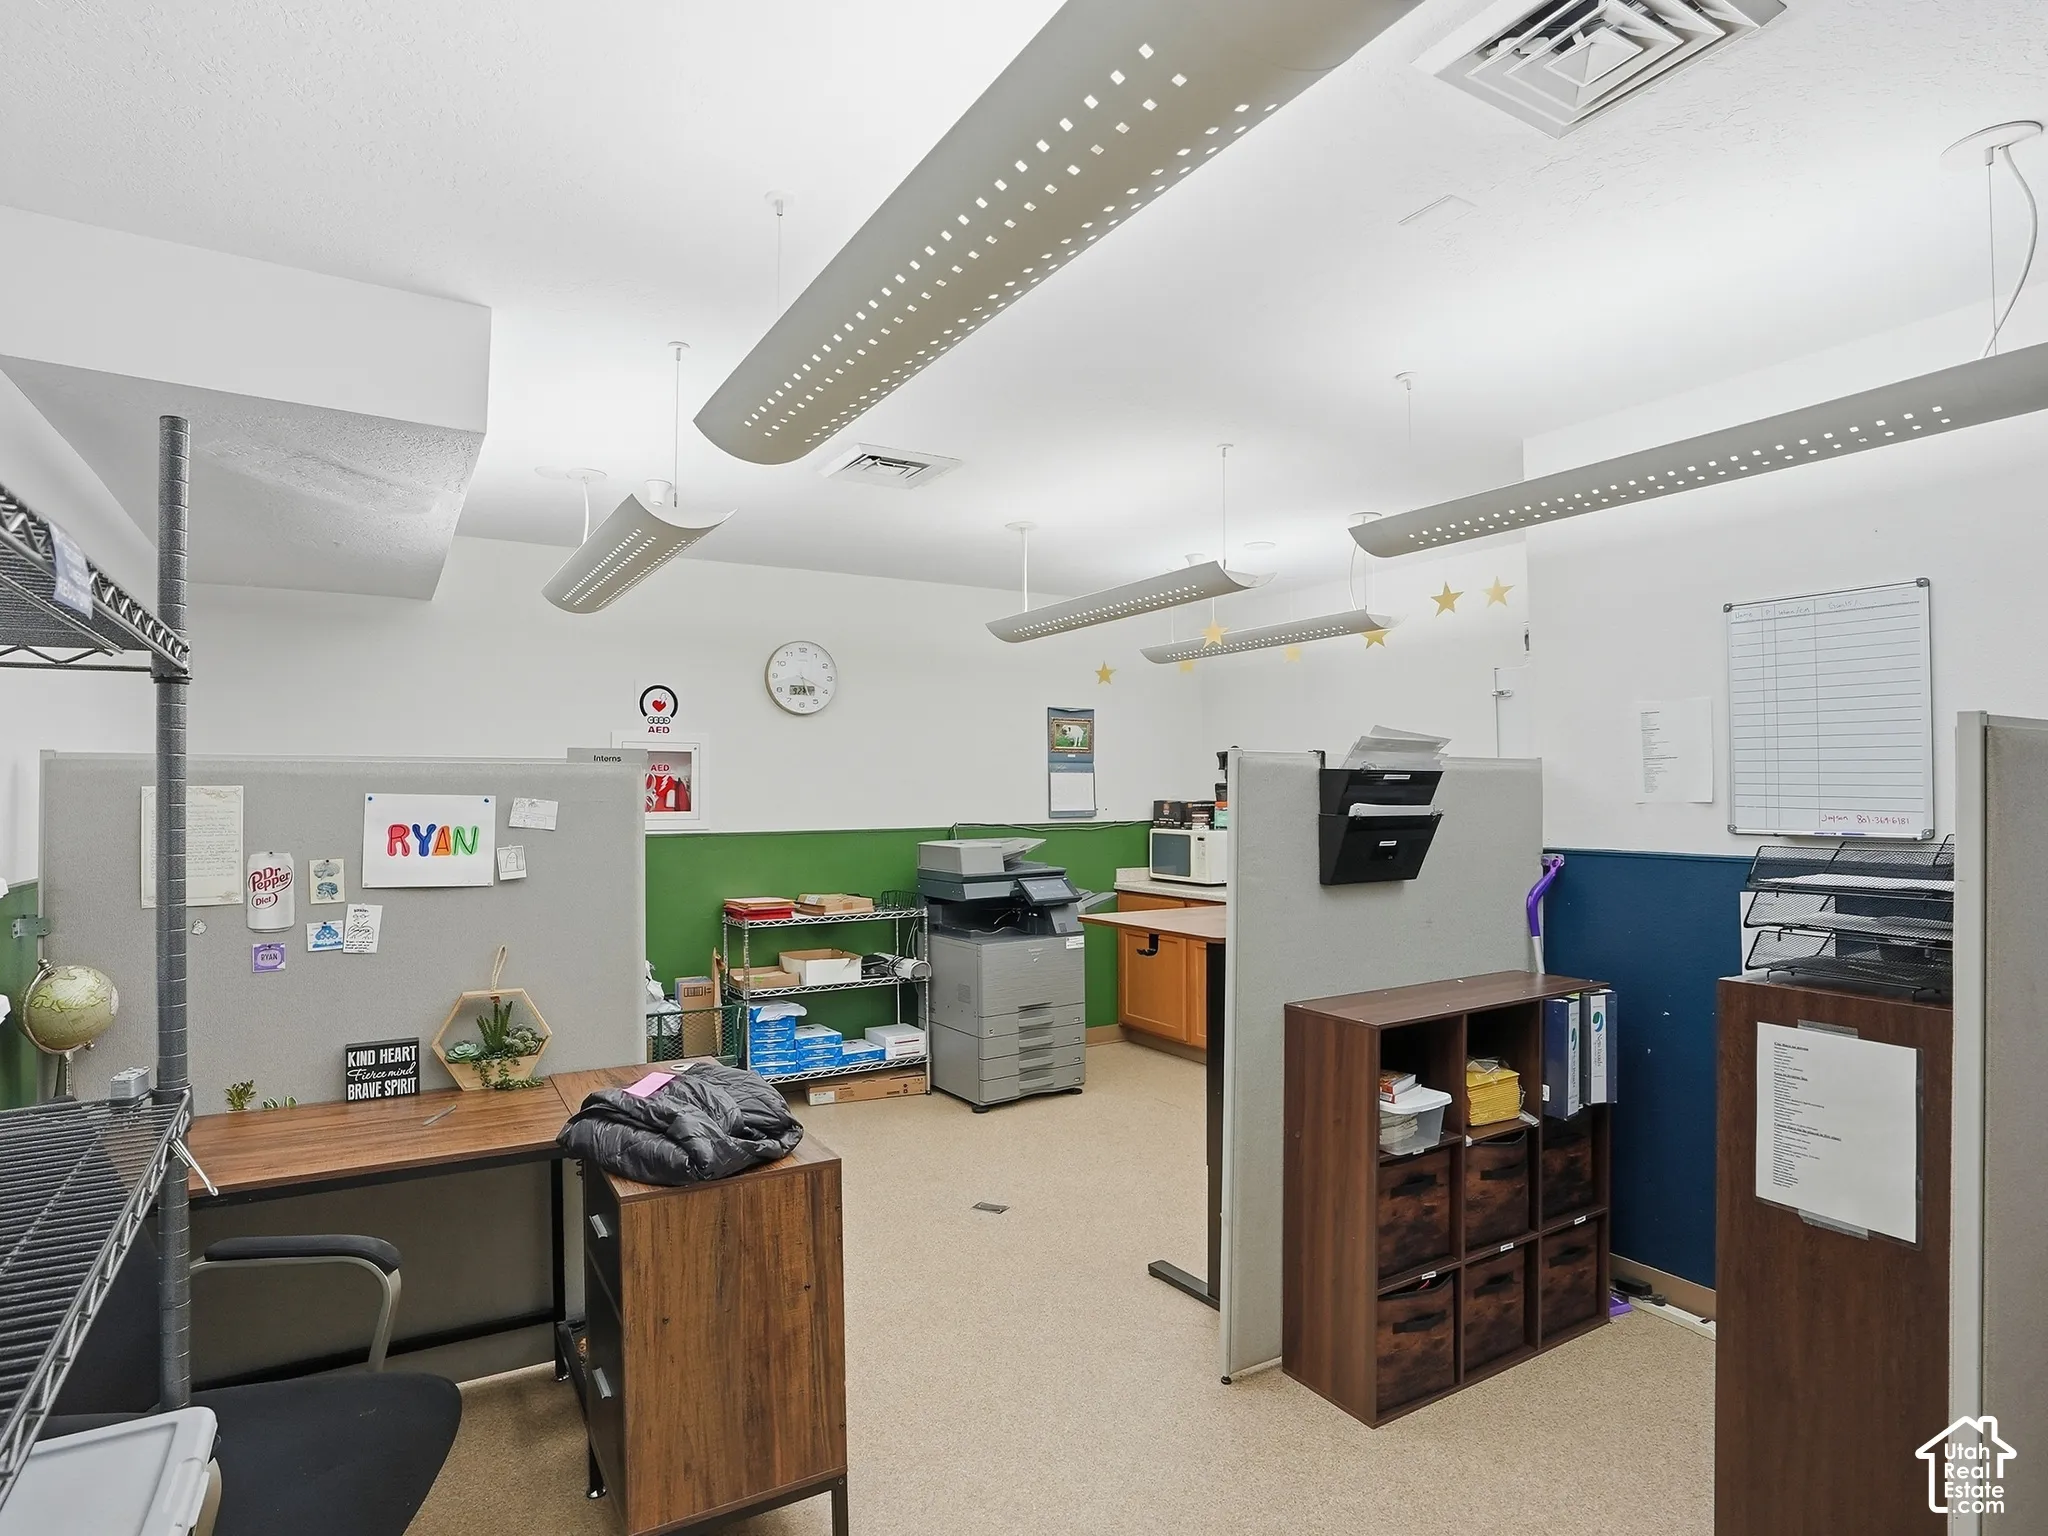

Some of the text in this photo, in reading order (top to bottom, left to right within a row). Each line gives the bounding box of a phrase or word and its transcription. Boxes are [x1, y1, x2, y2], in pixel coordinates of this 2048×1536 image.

[386, 823, 480, 857] RYAN
[249, 871, 291, 892] Pepper
[263, 867, 281, 880] Dr
[255, 897, 271, 906] Diet
[260, 952, 278, 962] RYAN
[348, 1046, 417, 1068] KIND HEART
[347, 1061, 416, 1081] Fierce mind
[348, 1077, 416, 1100] BRAVE SPIRIT
